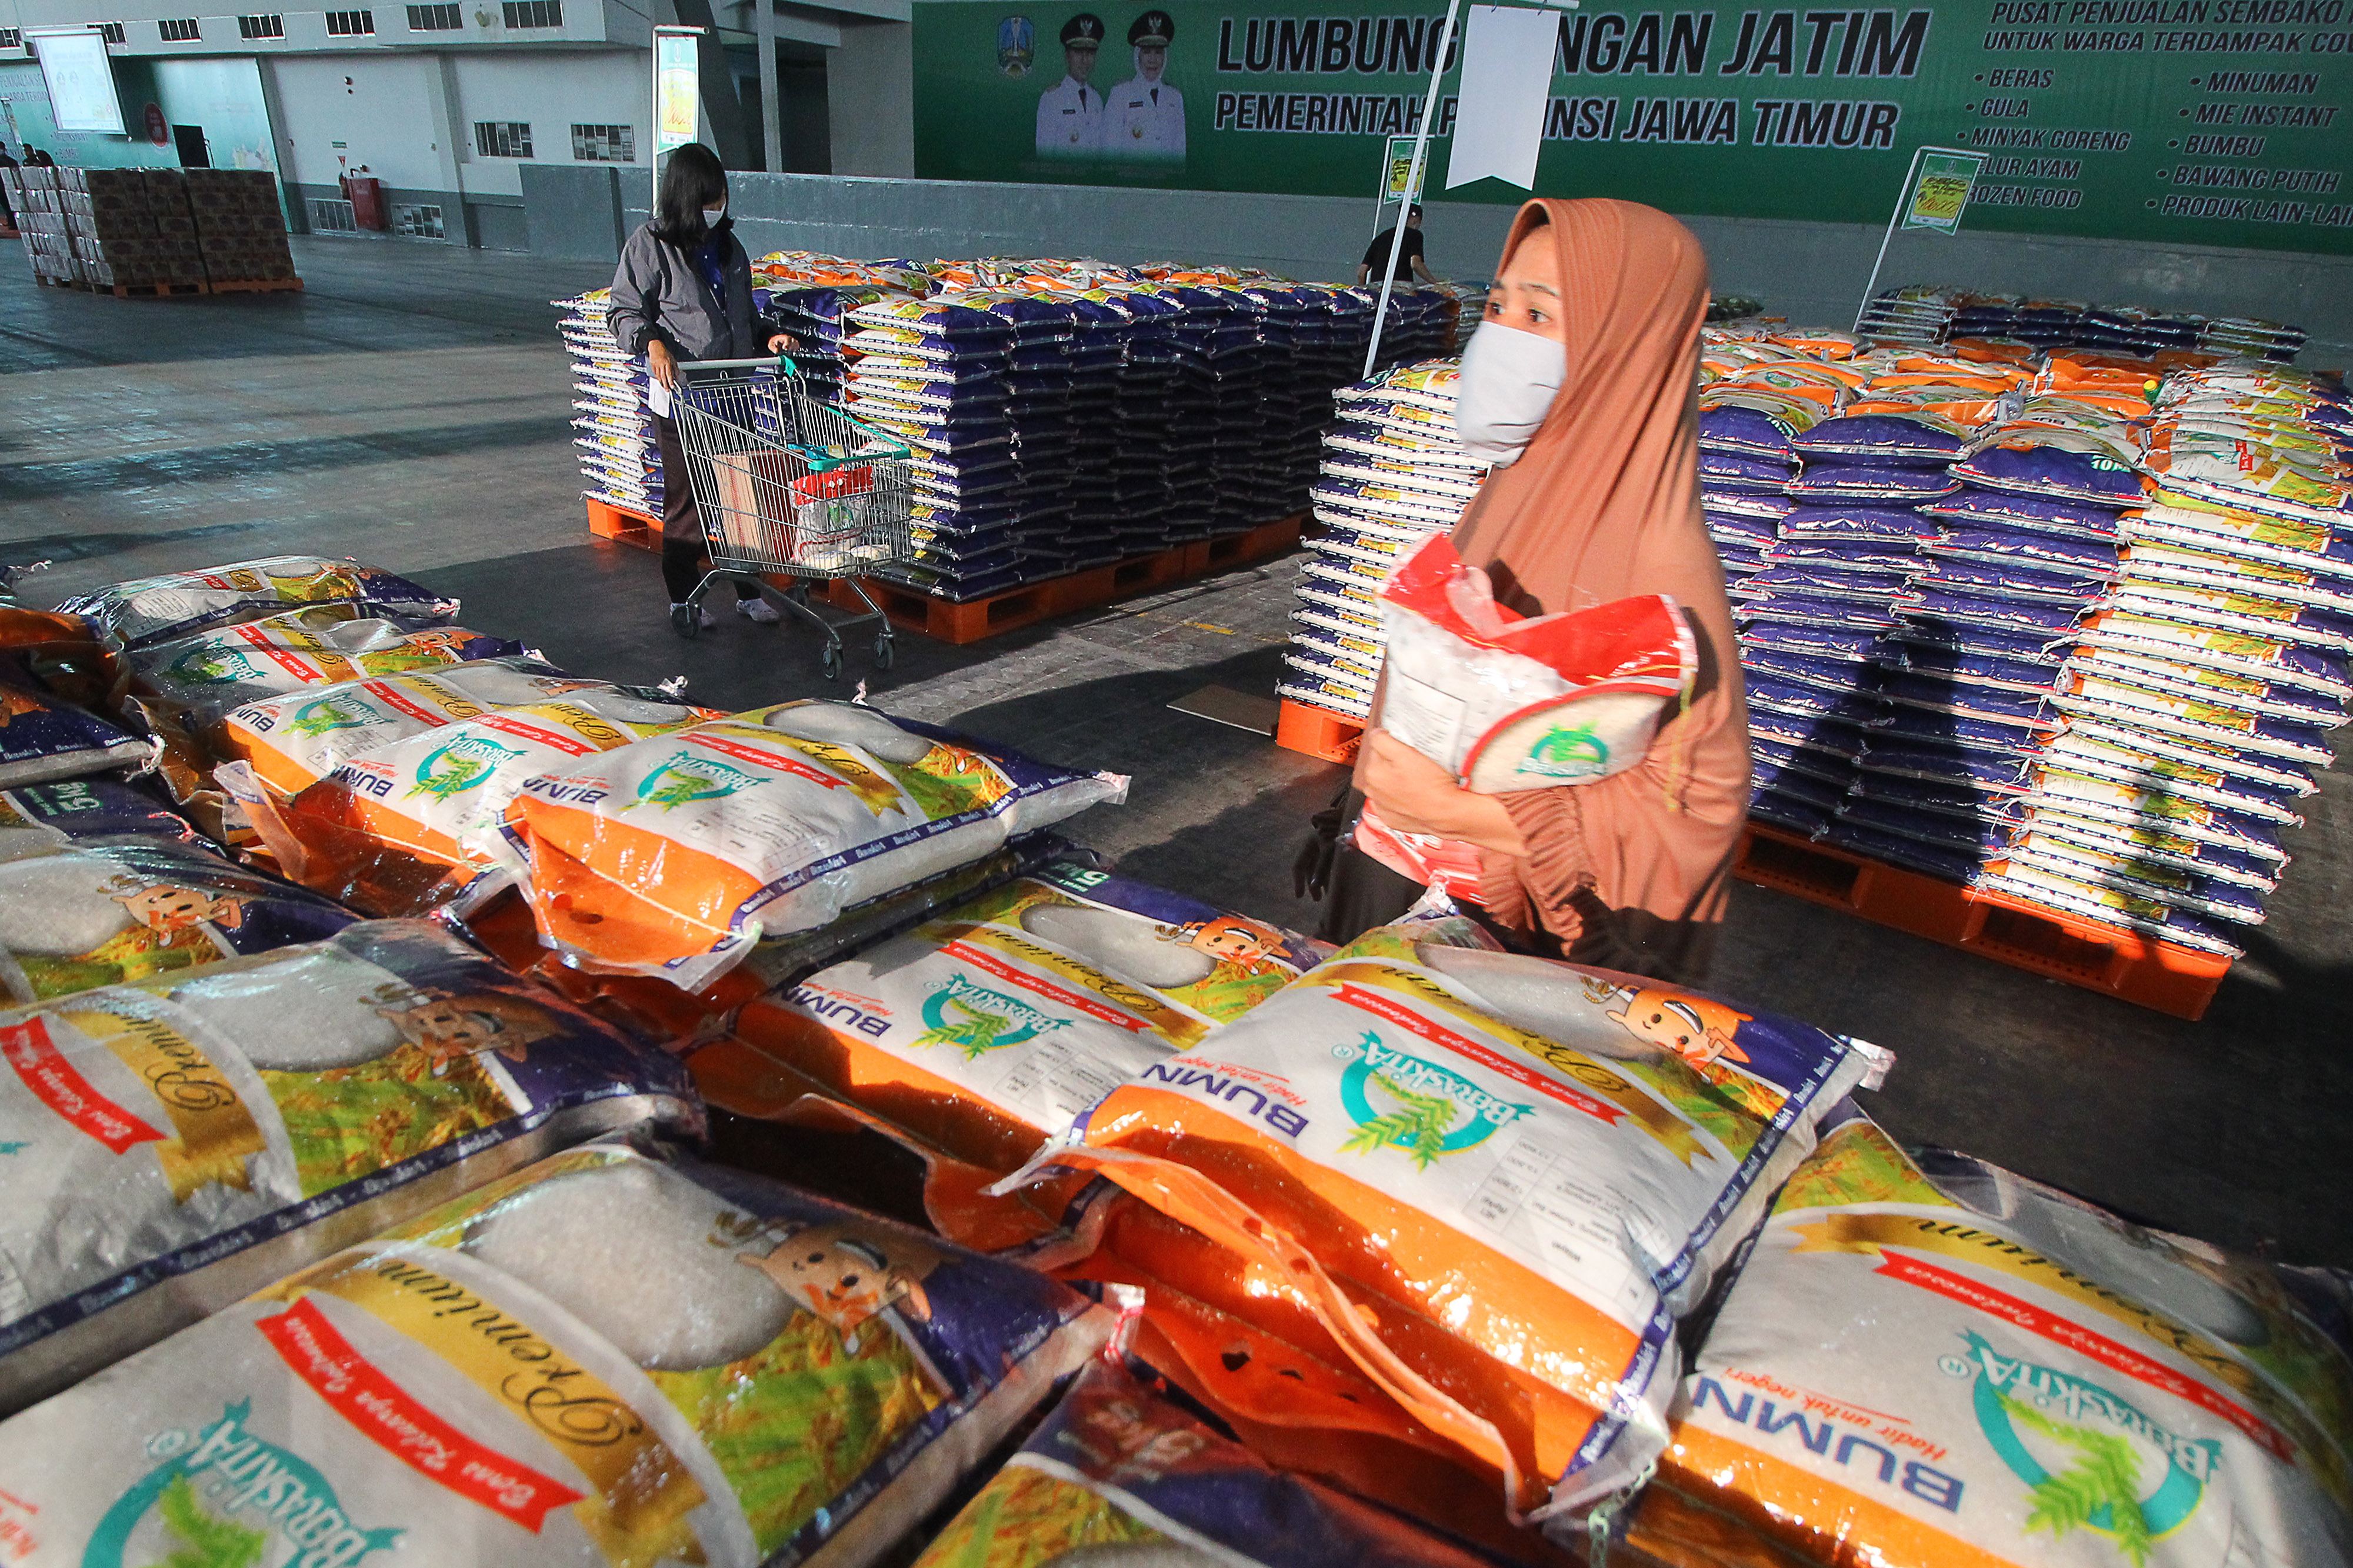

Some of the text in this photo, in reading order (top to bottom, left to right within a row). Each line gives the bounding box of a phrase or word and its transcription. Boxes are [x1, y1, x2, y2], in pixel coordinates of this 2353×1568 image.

[1991, 1, 2067, 24] PUSAT
[2068, 1, 2208, 24] PENJUALAN
[2214, 0, 2343, 24] SEMBAKO
[1218, 9, 1930, 77] LUMBUNG NGAN JATIM
[1983, 31, 2058, 51] UNTUK
[2062, 31, 2145, 52] WARGA
[2152, 31, 2306, 53] TERDAMPAK
[1988, 68, 2055, 89] BERAS
[2205, 71, 2321, 94] MINUMAN
[1980, 98, 2029, 118] GULA
[2194, 103, 2339, 128] MIE INSTANT
[1214, 92, 1431, 136] PEMERINTAH
[1622, 97, 1737, 144] JAWA
[1752, 101, 1900, 149] TIMUR
[1971, 127, 2132, 151] MINYAK GORENG
[2182, 135, 2267, 158] BUMBU
[2024, 159, 2082, 179] AYAM
[2171, 165, 2342, 194] BAWANG PUTIH
[1969, 185, 2028, 205] ROZEN
[2030, 189, 2082, 208] FOOD
[2161, 195, 2252, 220] PRODUK
[1140, 1062, 1309, 1139] BUMN
[1264, 1083, 1308, 1107] Hadir
[378, 1260, 644, 1447] Premium
[1723, 1366, 1947, 1462] Hadir untuk negeri
[1693, 1376, 1965, 1514] BUMN
